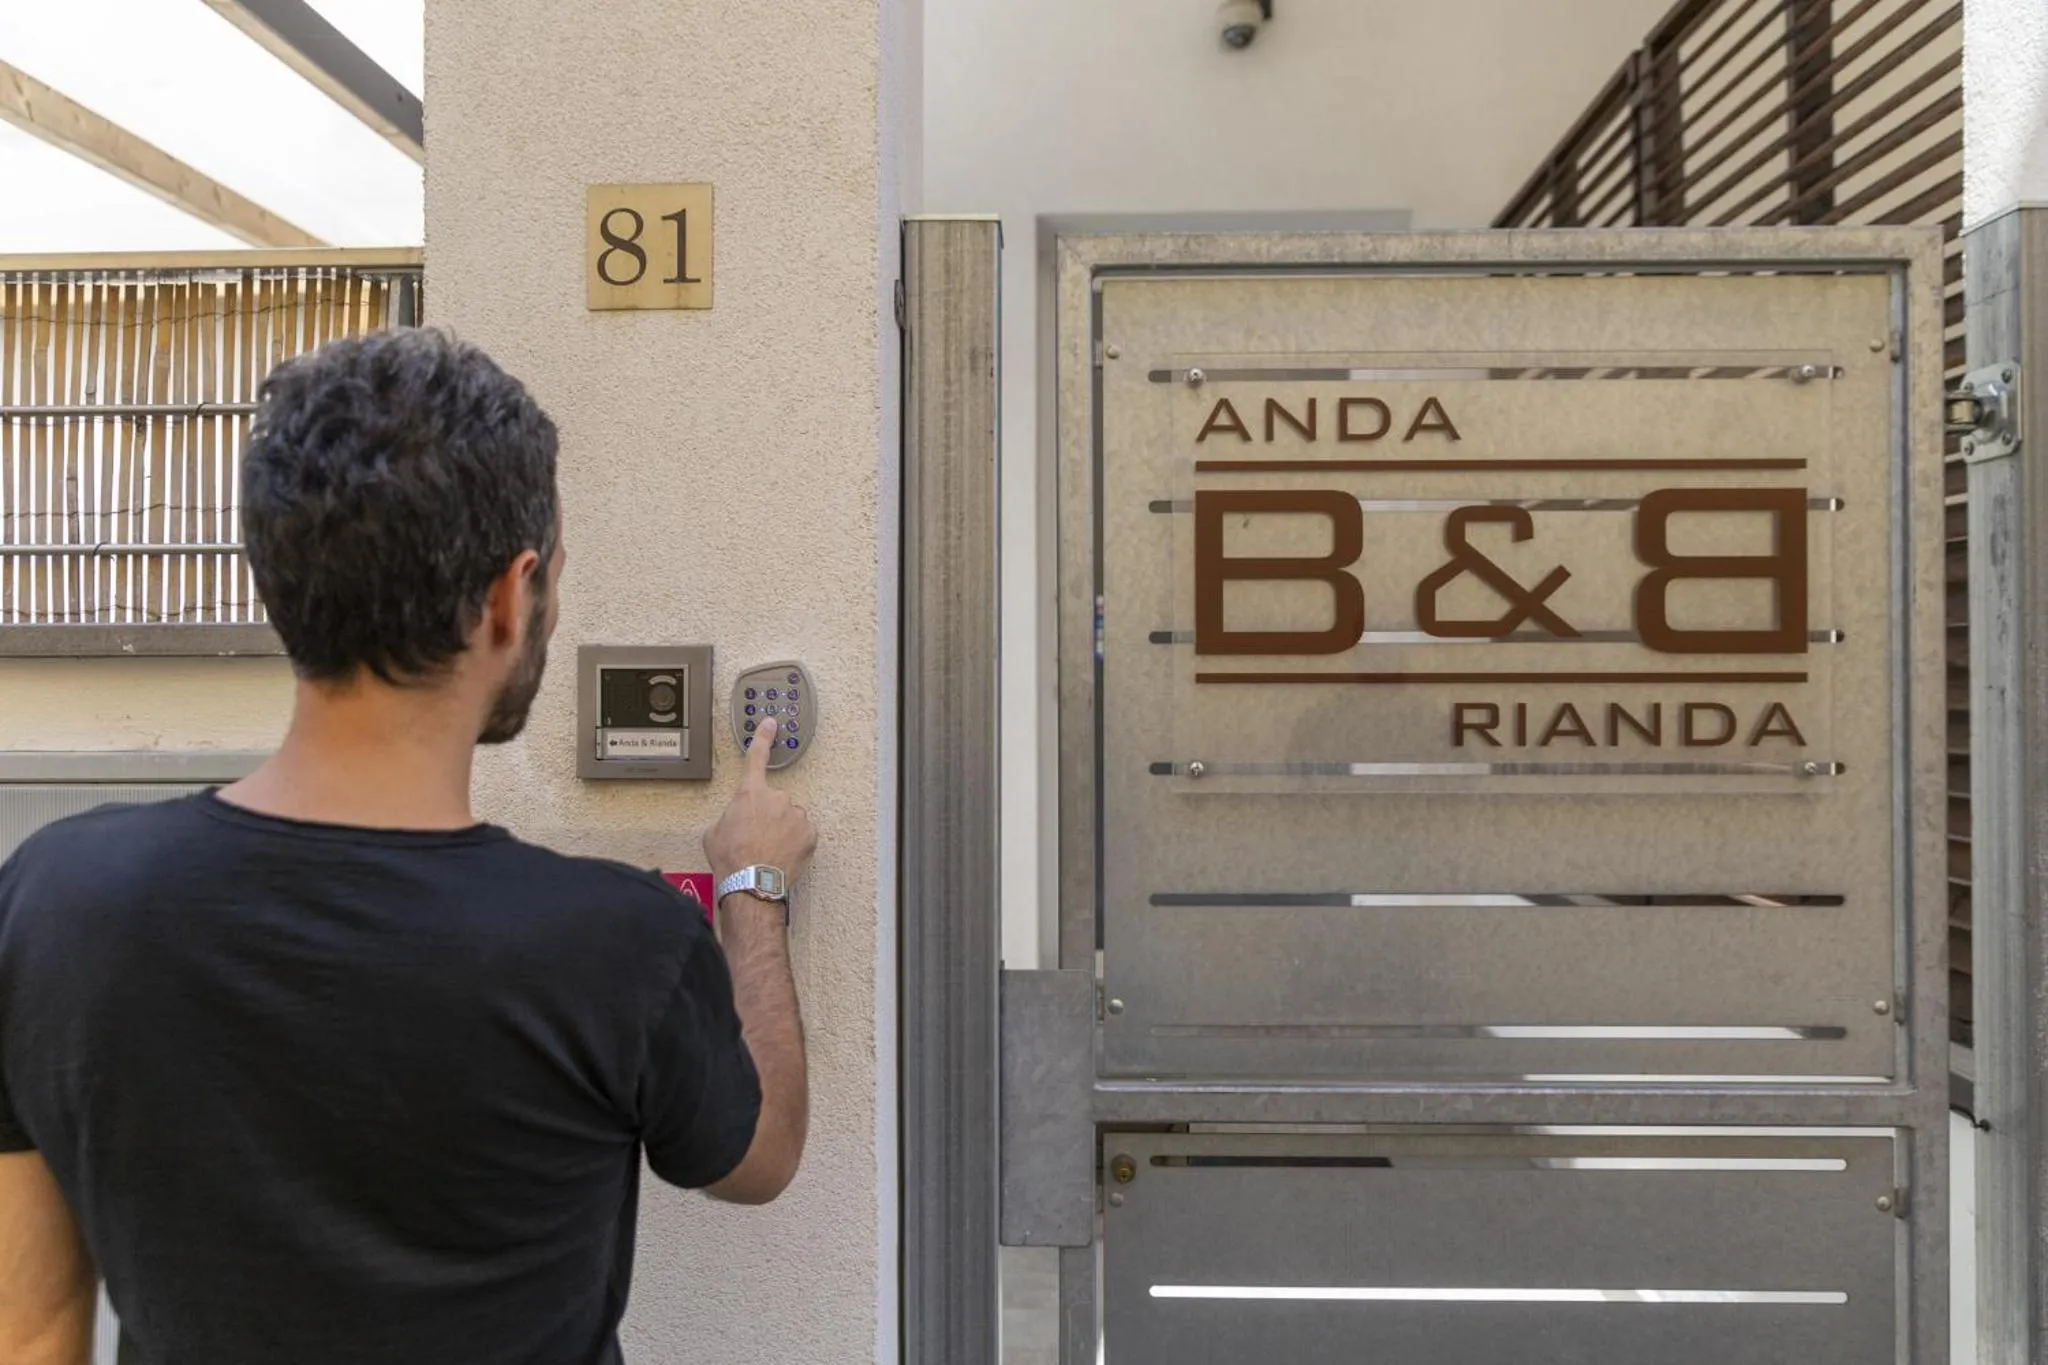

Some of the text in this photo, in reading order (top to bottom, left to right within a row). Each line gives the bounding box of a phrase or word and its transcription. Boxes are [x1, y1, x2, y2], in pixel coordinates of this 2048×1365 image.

[597, 207, 701, 286] 81
[1196, 396, 1461, 444] ANDA
[1452, 701, 1807, 748] RIANDA
